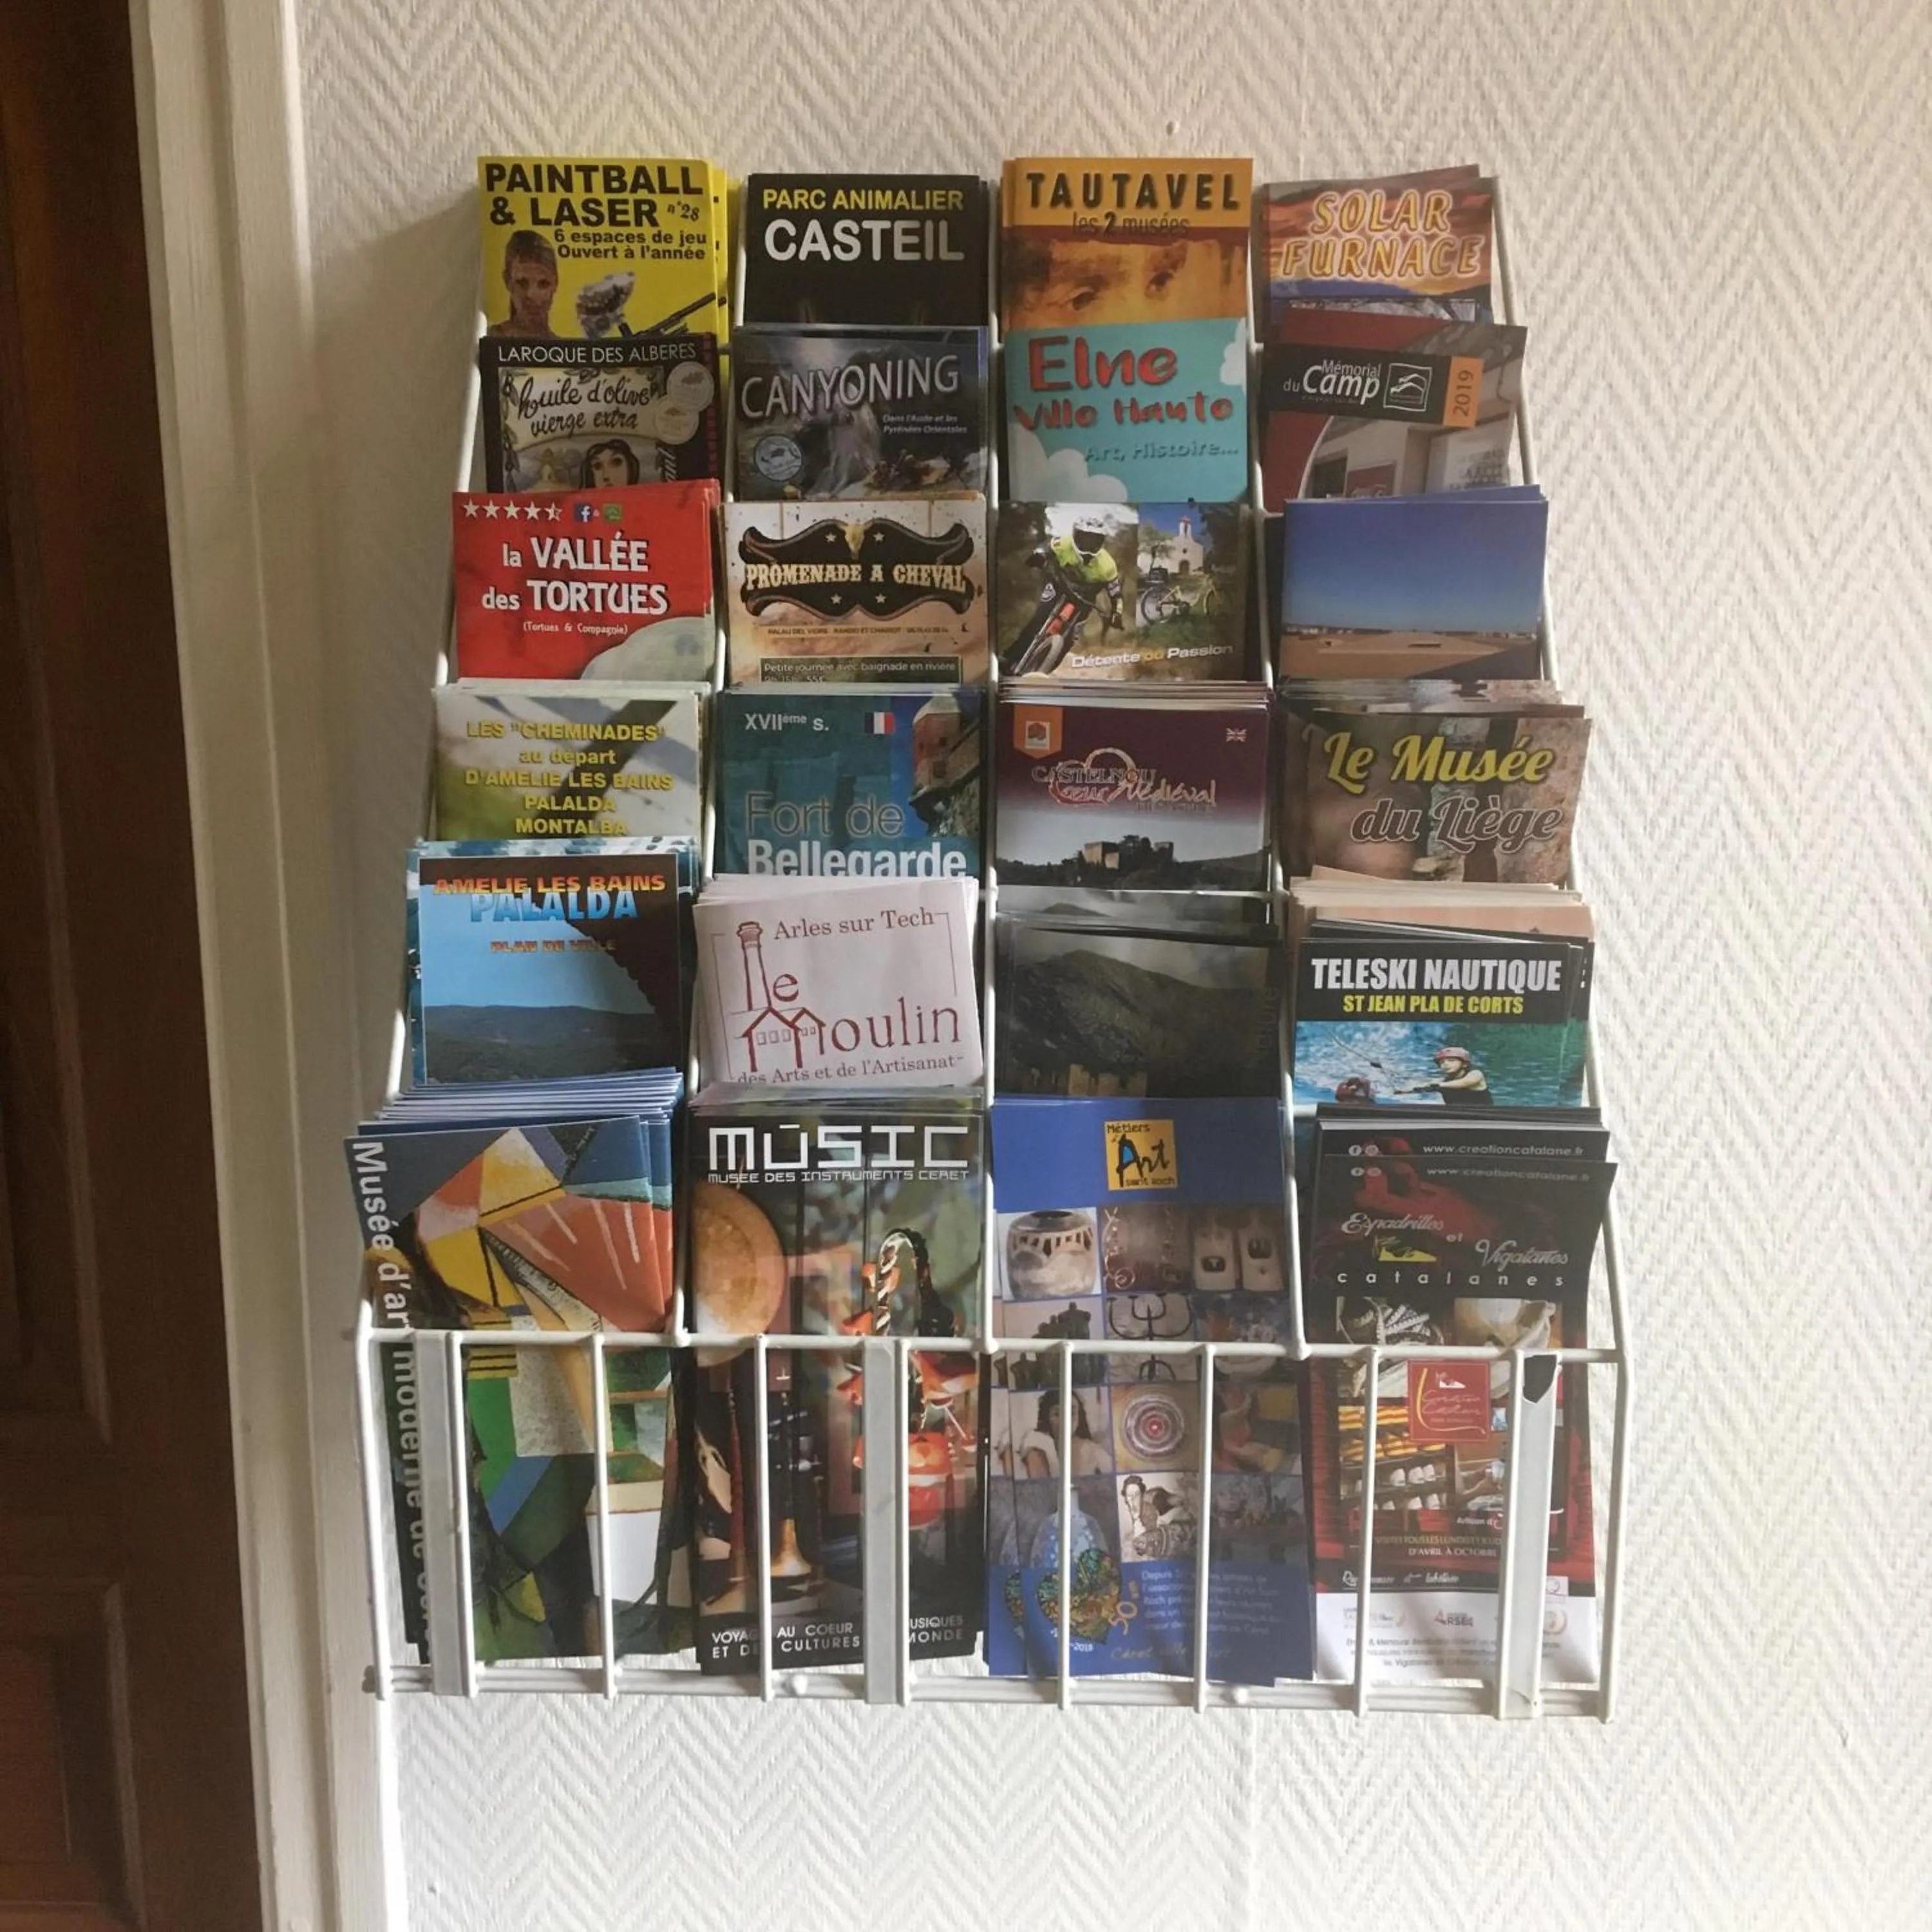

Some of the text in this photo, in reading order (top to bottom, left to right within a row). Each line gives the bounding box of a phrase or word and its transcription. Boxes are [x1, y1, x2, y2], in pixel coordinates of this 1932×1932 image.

[485, 163, 703, 194] PAINTBALL
[1026, 173, 1240, 210] TAUTAVEL
[490, 196, 516, 225] &
[530, 197, 659, 227] LASER
[762, 189, 964, 211] PARC ANIMALIER
[1309, 189, 1453, 234] SOLAR
[554, 229, 706, 248] 6 espaces de jeu
[1073, 211, 1191, 237] les 2 musées
[558, 245, 705, 260] Ouvert à l'année
[764, 218, 965, 261] CASTEIL
[1282, 235, 1486, 279] FURNACE
[498, 343, 697, 363] LAROQUE DES ALBERES
[1028, 335, 1178, 392] Elne
[1321, 359, 1381, 379] Mémorial
[517, 375, 650, 419] huile d'olive
[741, 354, 960, 419] CANYONING
[1282, 379, 1301, 392] du
[1302, 365, 1381, 405] Camp
[1452, 370, 1474, 417] 2019
[531, 406, 639, 438] vierge extra
[502, 531, 649, 573] la VALLÉE
[746, 564, 967, 594] PROMENADE A CHEVAL
[481, 580, 669, 616] des TORTUES
[764, 663, 793, 672] Petite
[860, 661, 908, 674] baignade
[1071, 652, 1141, 669] Détente
[1166, 645, 1234, 659] Passion
[466, 721, 506, 738] LES
[518, 750, 544, 764] au
[1323, 731, 1557, 795] Le Musée
[568, 772, 607, 788] LES
[612, 772, 675, 791] BAINS
[524, 795, 618, 813] PALALDA
[745, 790, 905, 838] Fort de
[515, 817, 629, 837] MONTALBA
[1350, 794, 1564, 854] du Liège
[748, 839, 967, 877] Bellegarde
[433, 875, 667, 895] AMELIE LES BAINS
[470, 887, 639, 923] PALALDA
[773, 906, 935, 940] Arles sur Tech
[1311, 958, 1562, 994] TELESKI NAUTIQUE
[1343, 995, 1524, 1014] ST JEAN PLA DE CORTS
[737, 1056, 956, 1084] des Arts et de l'Artisanat
[1106, 1122, 1151, 1134] Métiers
[1115, 1133, 1171, 1188] Art
[1423, 1144, 1584, 1156] www.creationcatalane.fr
[765, 1172, 796, 1183] DES
[800, 1170, 914, 1182] INSTRUMENTS
[918, 1170, 969, 1181] CERET
[1426, 1167, 1590, 1181] www.creationcatalane.fr
[352, 1141, 399, 1251] Musée
[376, 1262, 413, 1331] d'ar
[1446, 1232, 1463, 1243] et
[776, 1625, 796, 1638] AU
[805, 1622, 853, 1636] COEUR
[909, 1614, 963, 1629] USIQUES
[712, 1645, 730, 1660] ET
[781, 1636, 860, 1653] CULTURES
